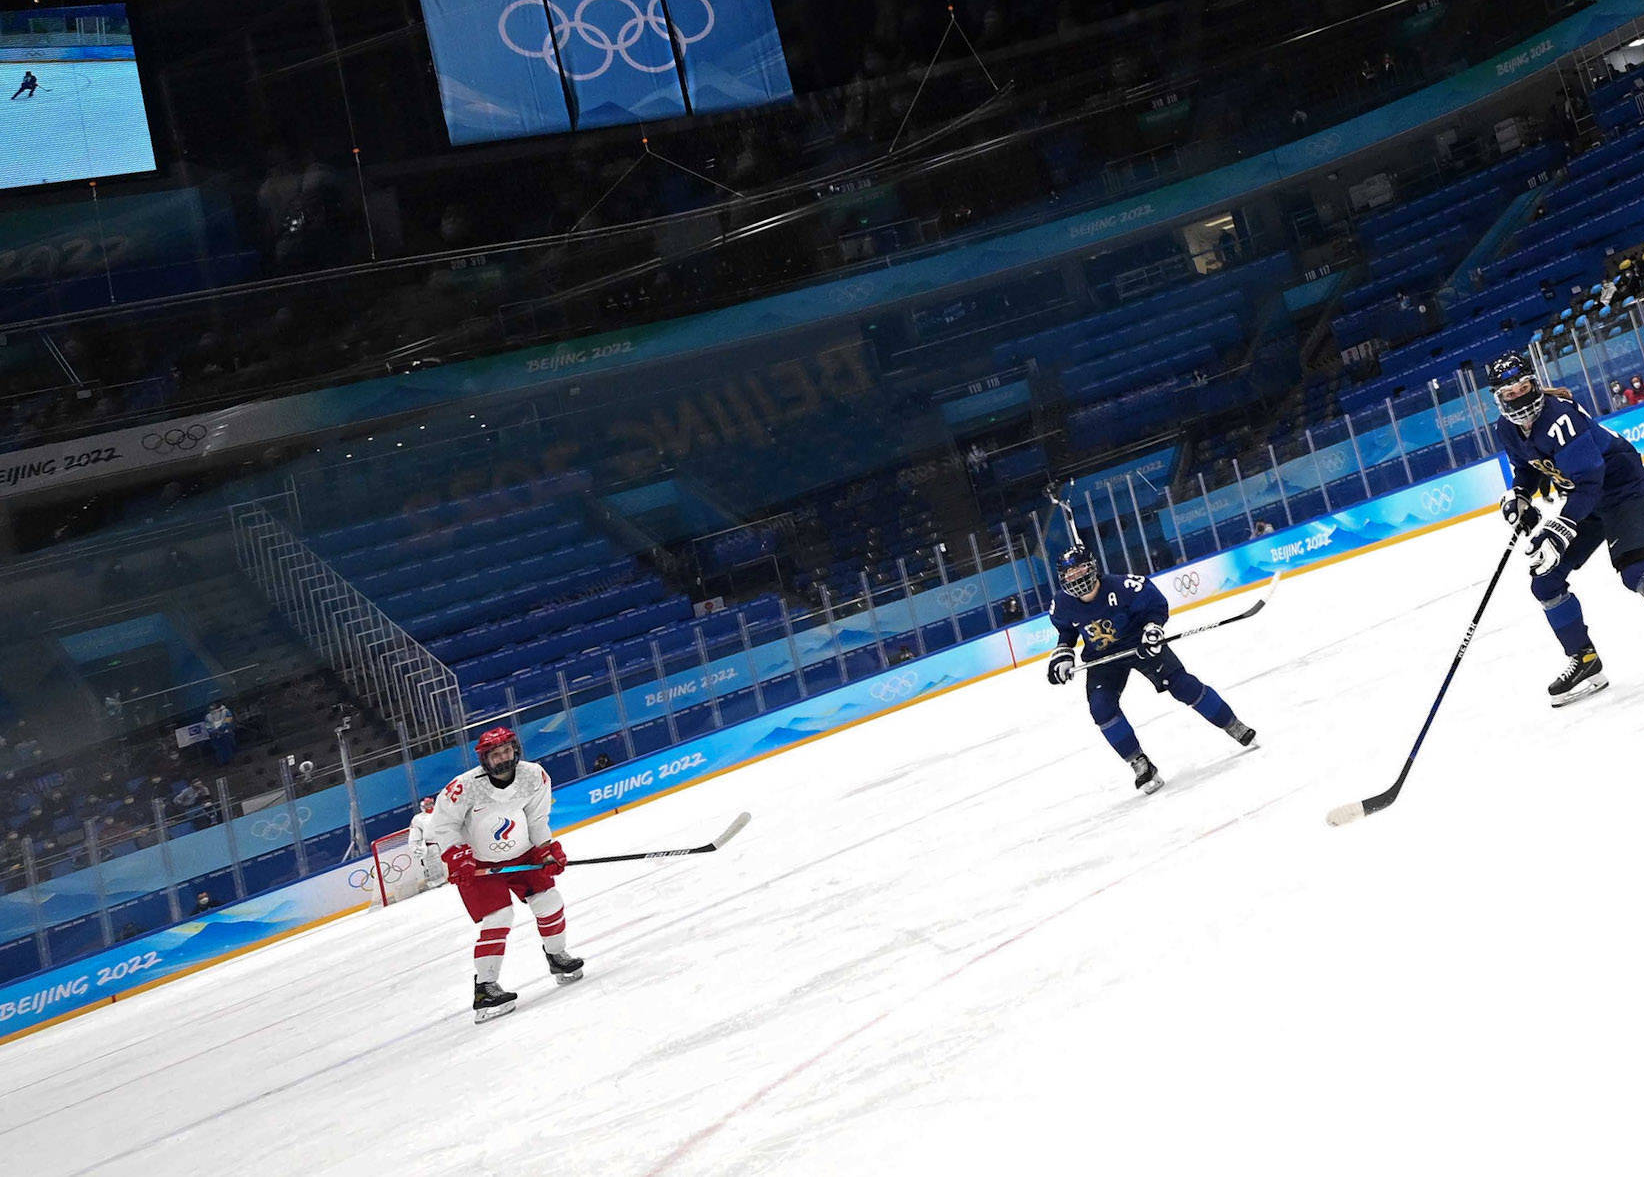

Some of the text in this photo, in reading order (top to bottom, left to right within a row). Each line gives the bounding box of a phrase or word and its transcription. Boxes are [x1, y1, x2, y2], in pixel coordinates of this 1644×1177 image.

[1547, 413, 1577, 447] 77
[63, 446, 123, 472] 2022
[1270, 540, 1305, 563] BEIJING
[1107, 591, 1119, 607] A
[644, 667, 738, 708] BEIJING 2022
[588, 751, 708, 805] BEIJING 2022
[0, 950, 163, 1022] BEIJING 2022
